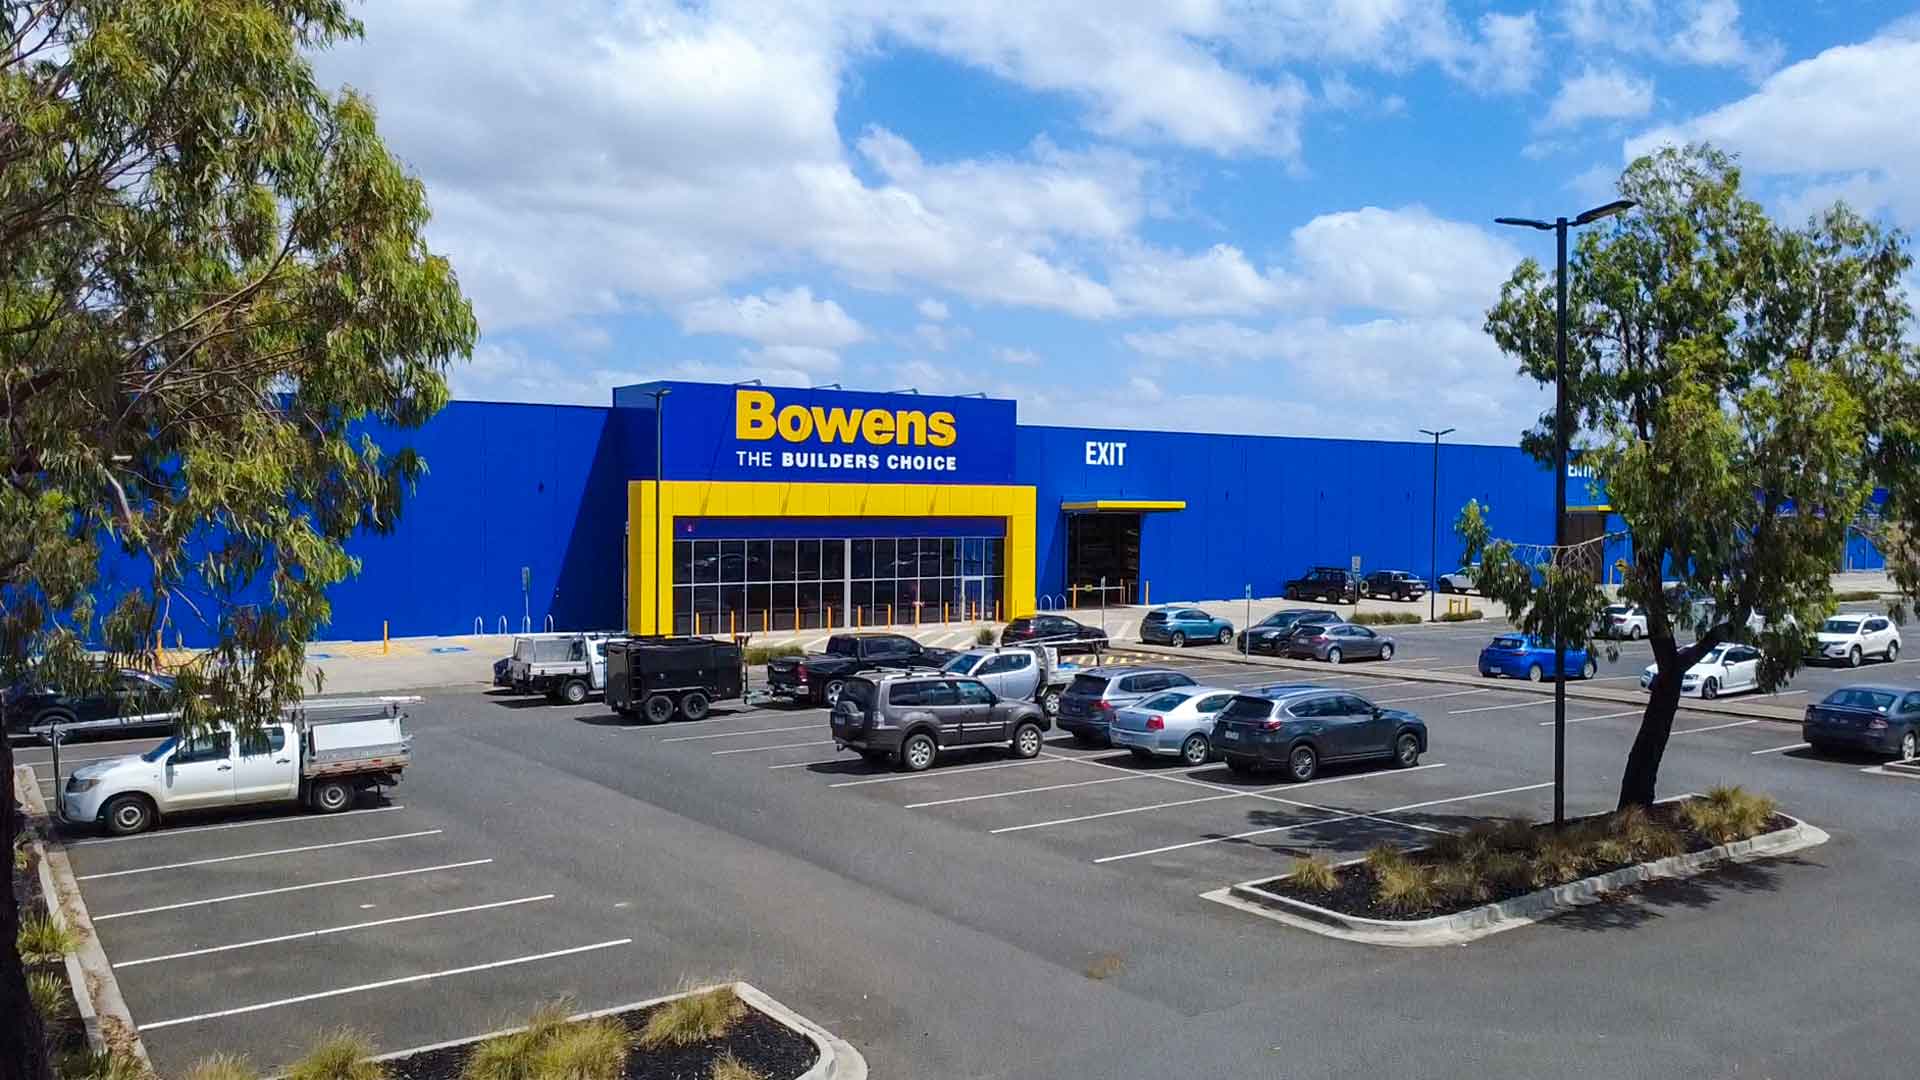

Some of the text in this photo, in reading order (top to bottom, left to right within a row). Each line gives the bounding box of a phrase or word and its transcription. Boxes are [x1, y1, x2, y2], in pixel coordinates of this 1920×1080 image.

[736, 389, 957, 447] Bowens
[736, 451, 957, 471] THE BUILDERS CHOICE
[1085, 441, 1127, 466] EXIT
